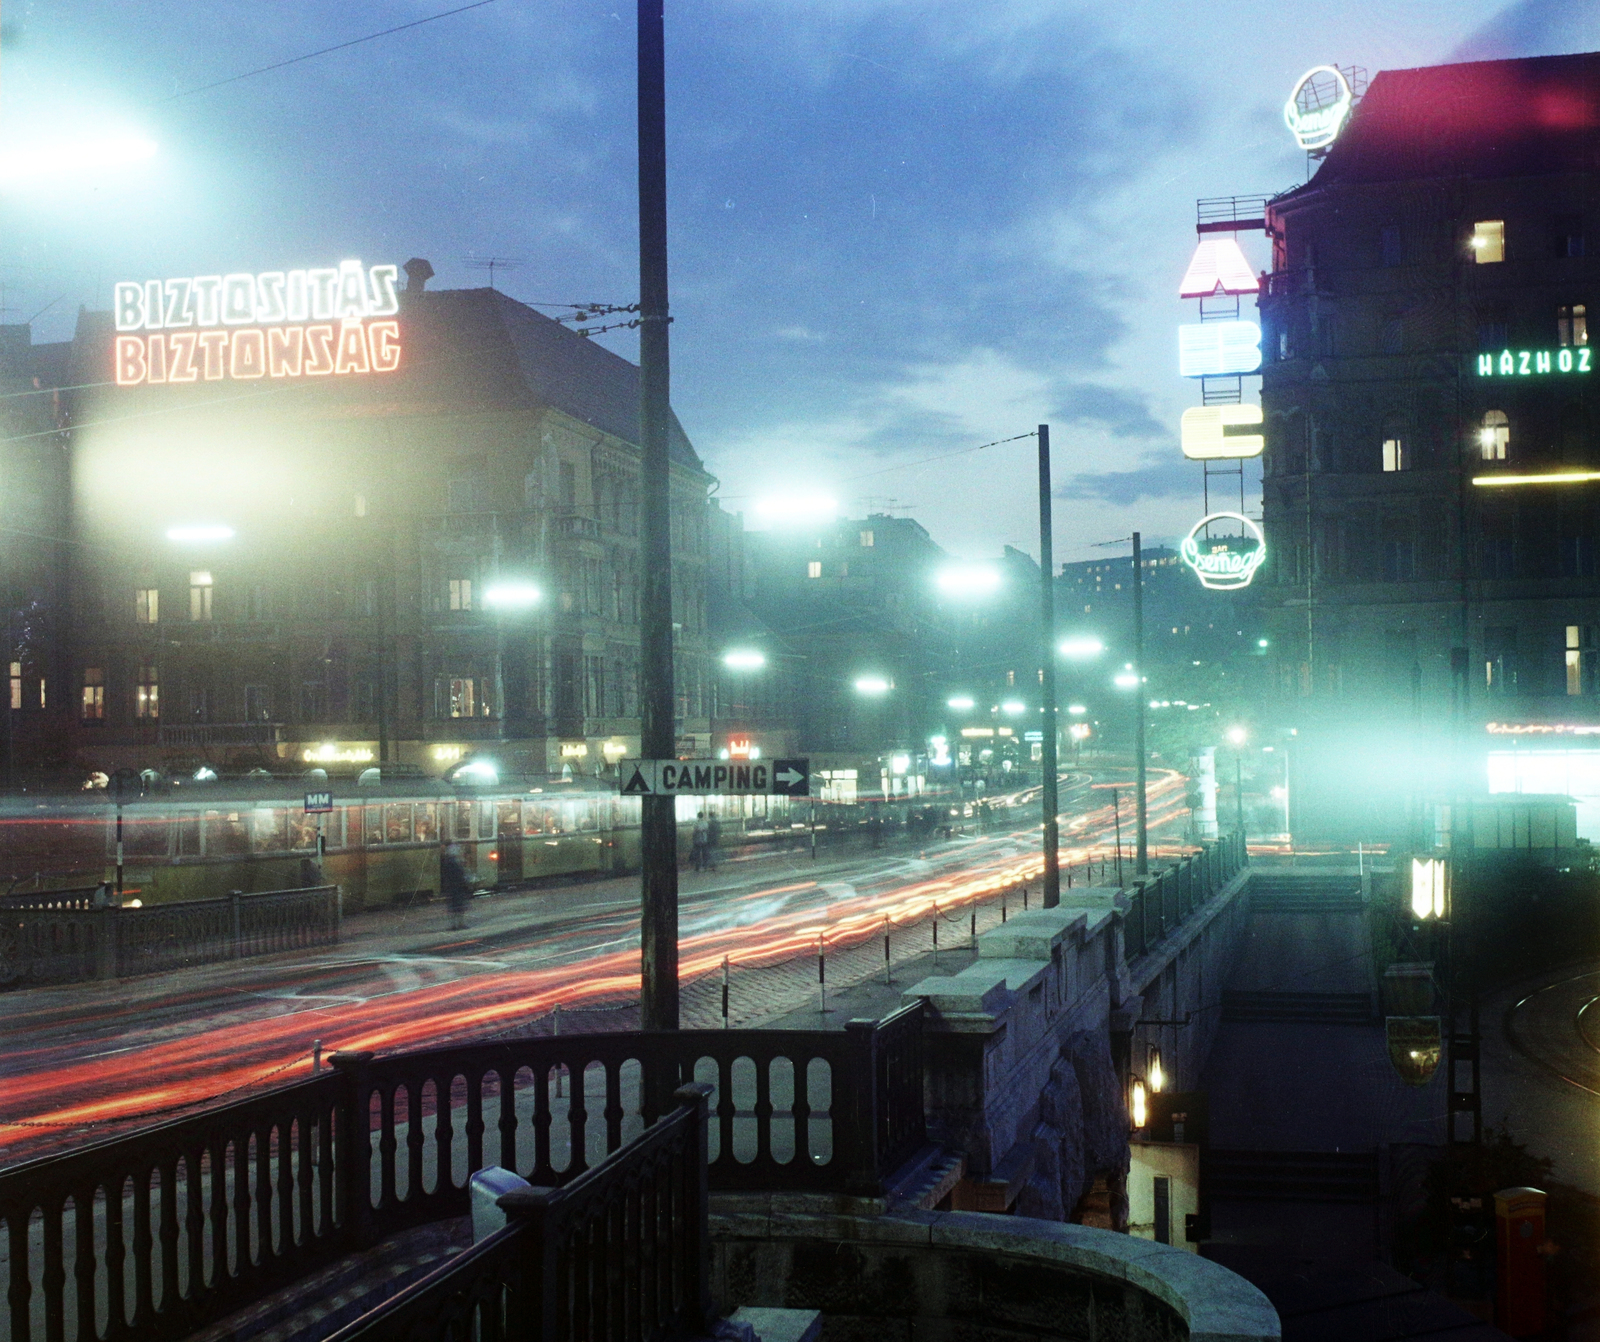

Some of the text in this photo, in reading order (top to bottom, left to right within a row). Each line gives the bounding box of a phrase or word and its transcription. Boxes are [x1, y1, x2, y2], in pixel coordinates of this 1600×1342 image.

[116, 317, 401, 385] BIZTONSÁG
[1179, 238, 1264, 459] ABC
[1478, 348, 1591, 376] HÁZHOZ
[662, 765, 767, 790] CAMPING
[307, 793, 329, 805] MM
